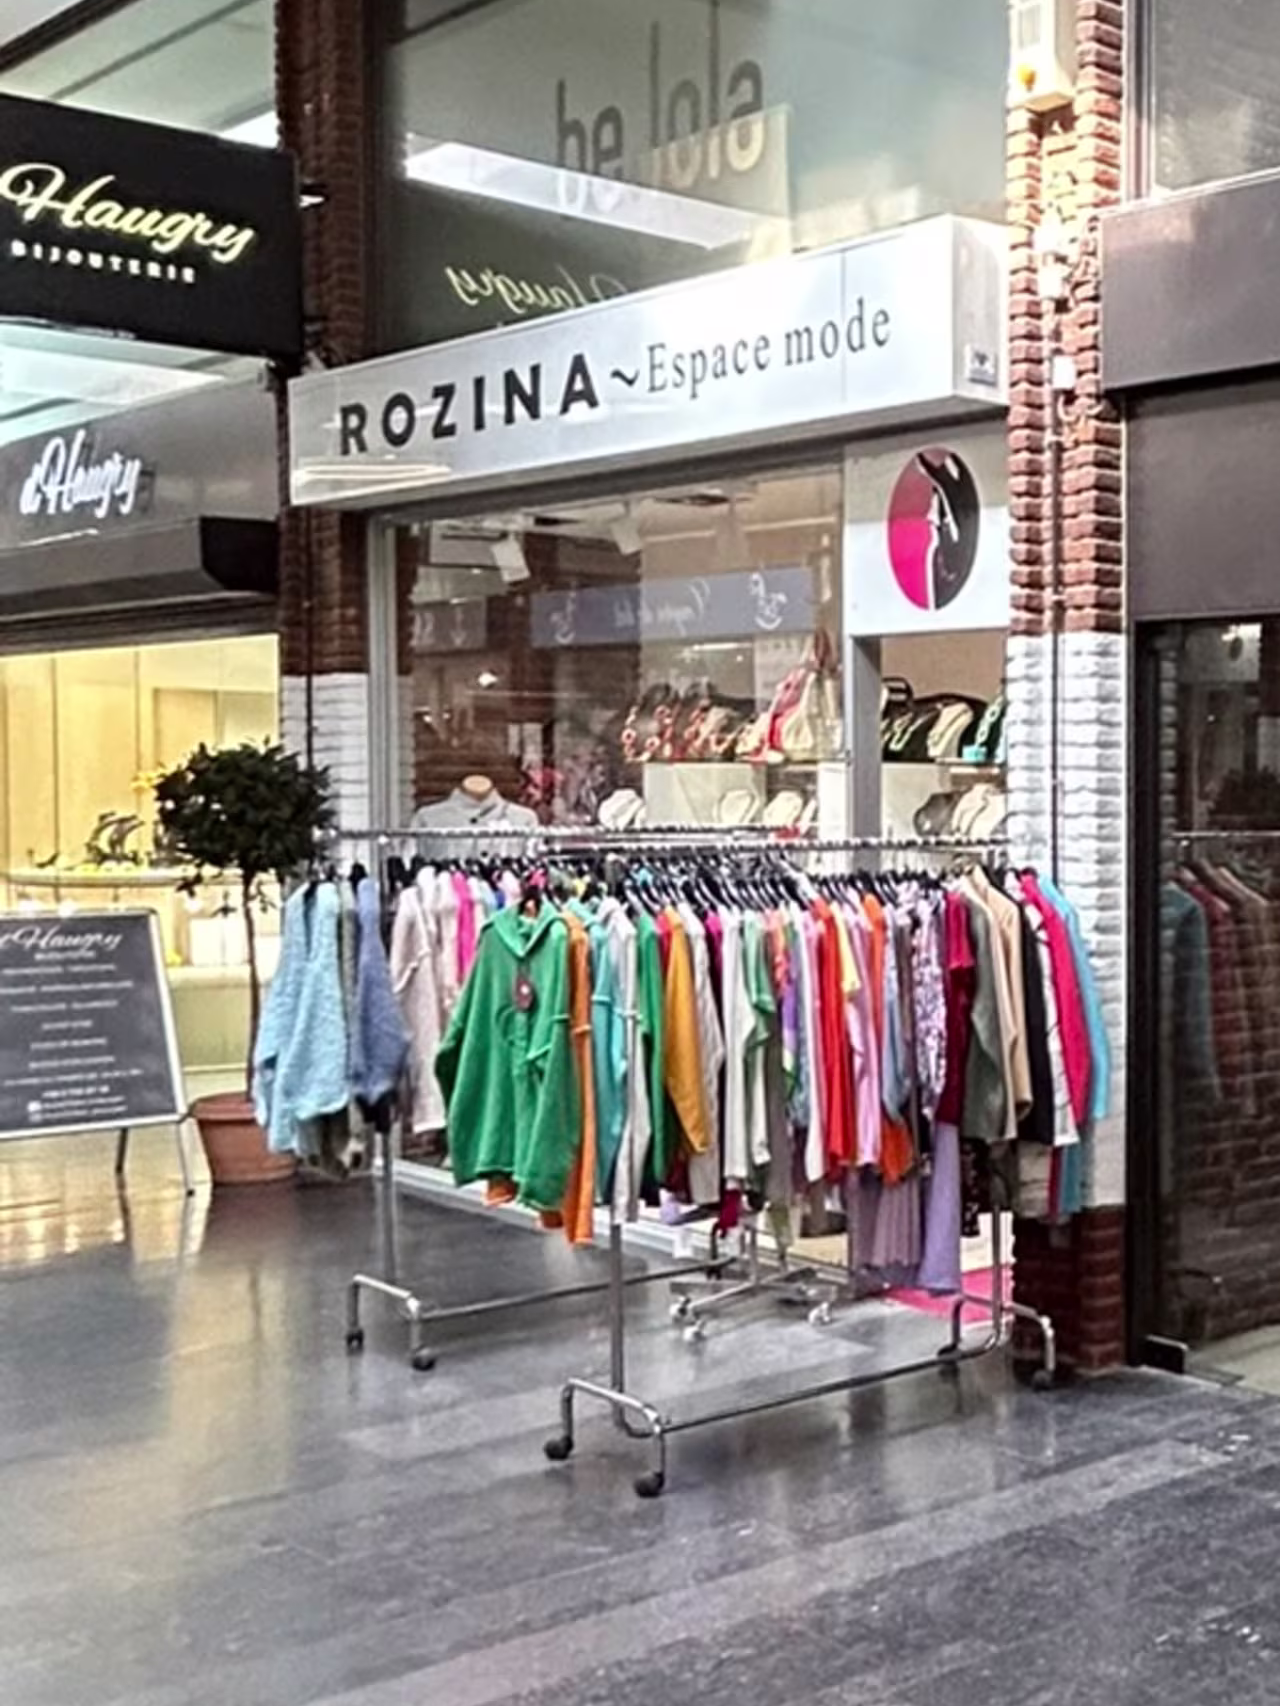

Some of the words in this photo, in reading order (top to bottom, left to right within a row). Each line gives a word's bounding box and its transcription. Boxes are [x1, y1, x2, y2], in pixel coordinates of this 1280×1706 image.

[556, 78, 623, 216] be
[10, 238, 195, 283] BIJOUTERIE
[339, 352, 599, 456] ROZINA
[646, 332, 771, 402] Espace
[784, 296, 892, 369] mode
